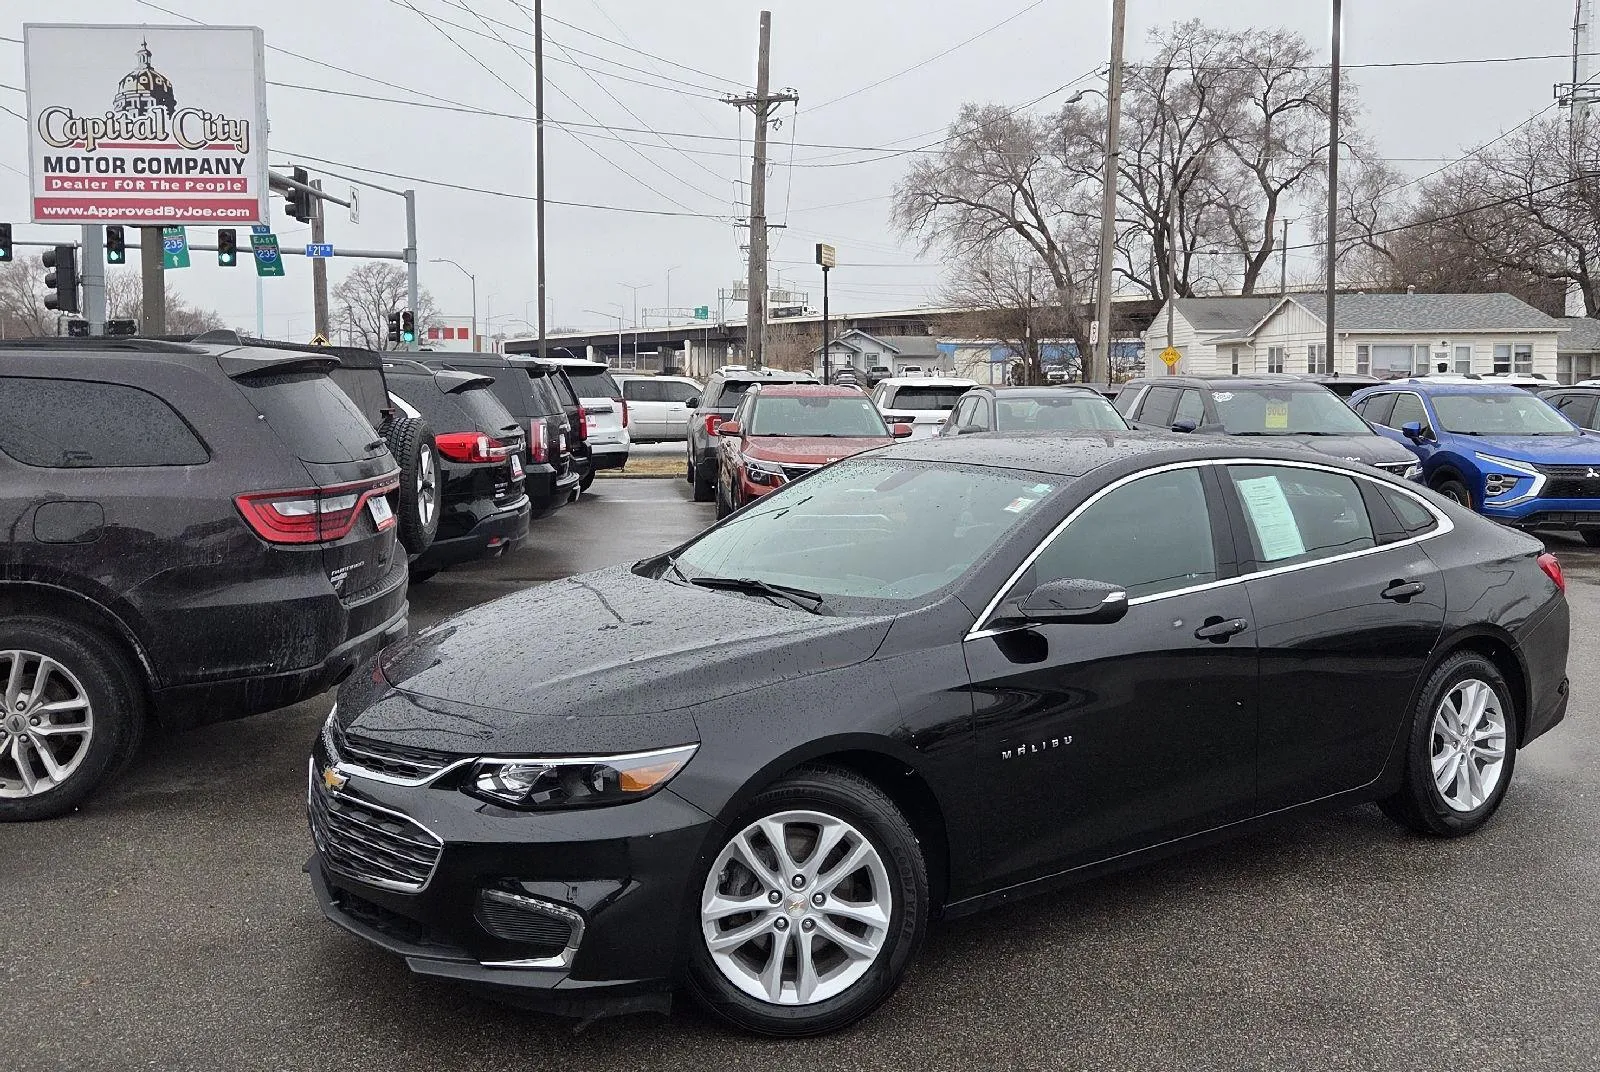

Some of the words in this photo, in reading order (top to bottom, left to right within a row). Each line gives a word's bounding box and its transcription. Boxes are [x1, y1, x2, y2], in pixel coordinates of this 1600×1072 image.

[38, 106, 169, 153] Capital
[172, 107, 250, 154] City
[43, 156, 126, 174] MOTOR
[132, 157, 246, 175] COMPANY
[52, 179, 108, 189] Dealer
[114, 180, 146, 190] FOR
[150, 180, 180, 190] The
[42, 205, 250, 218] www.ApprovedByJoe.com
[164, 239, 183, 249] 235
[257, 249, 276, 258] 235
[1267, 407, 1287, 416] SOLD
[1001, 735, 1073, 760] MALIBU
